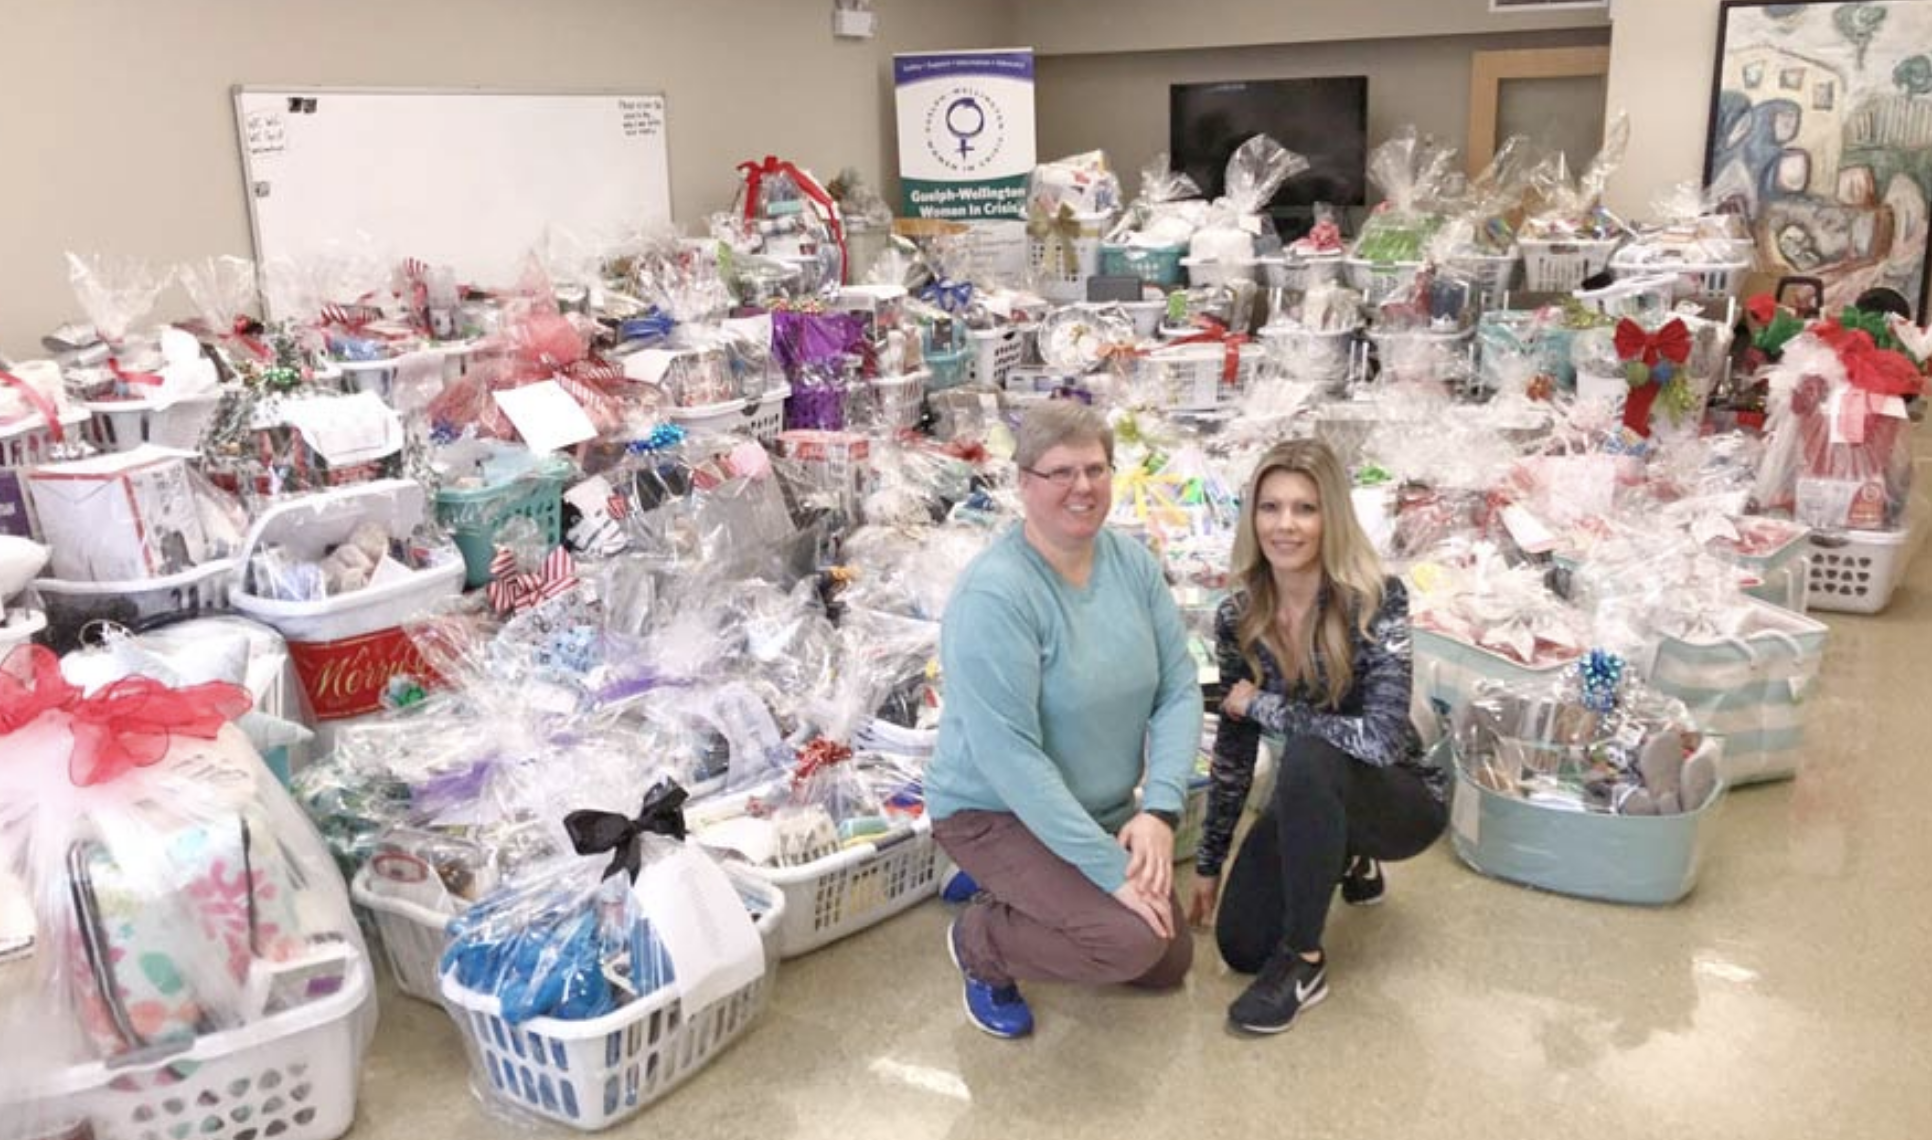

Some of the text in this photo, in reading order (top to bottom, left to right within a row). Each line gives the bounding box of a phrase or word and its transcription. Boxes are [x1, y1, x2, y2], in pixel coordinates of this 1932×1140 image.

[911, 187, 1026, 204] Guelph-Wellington
[919, 204, 967, 218] Women
[969, 203, 982, 216] In
